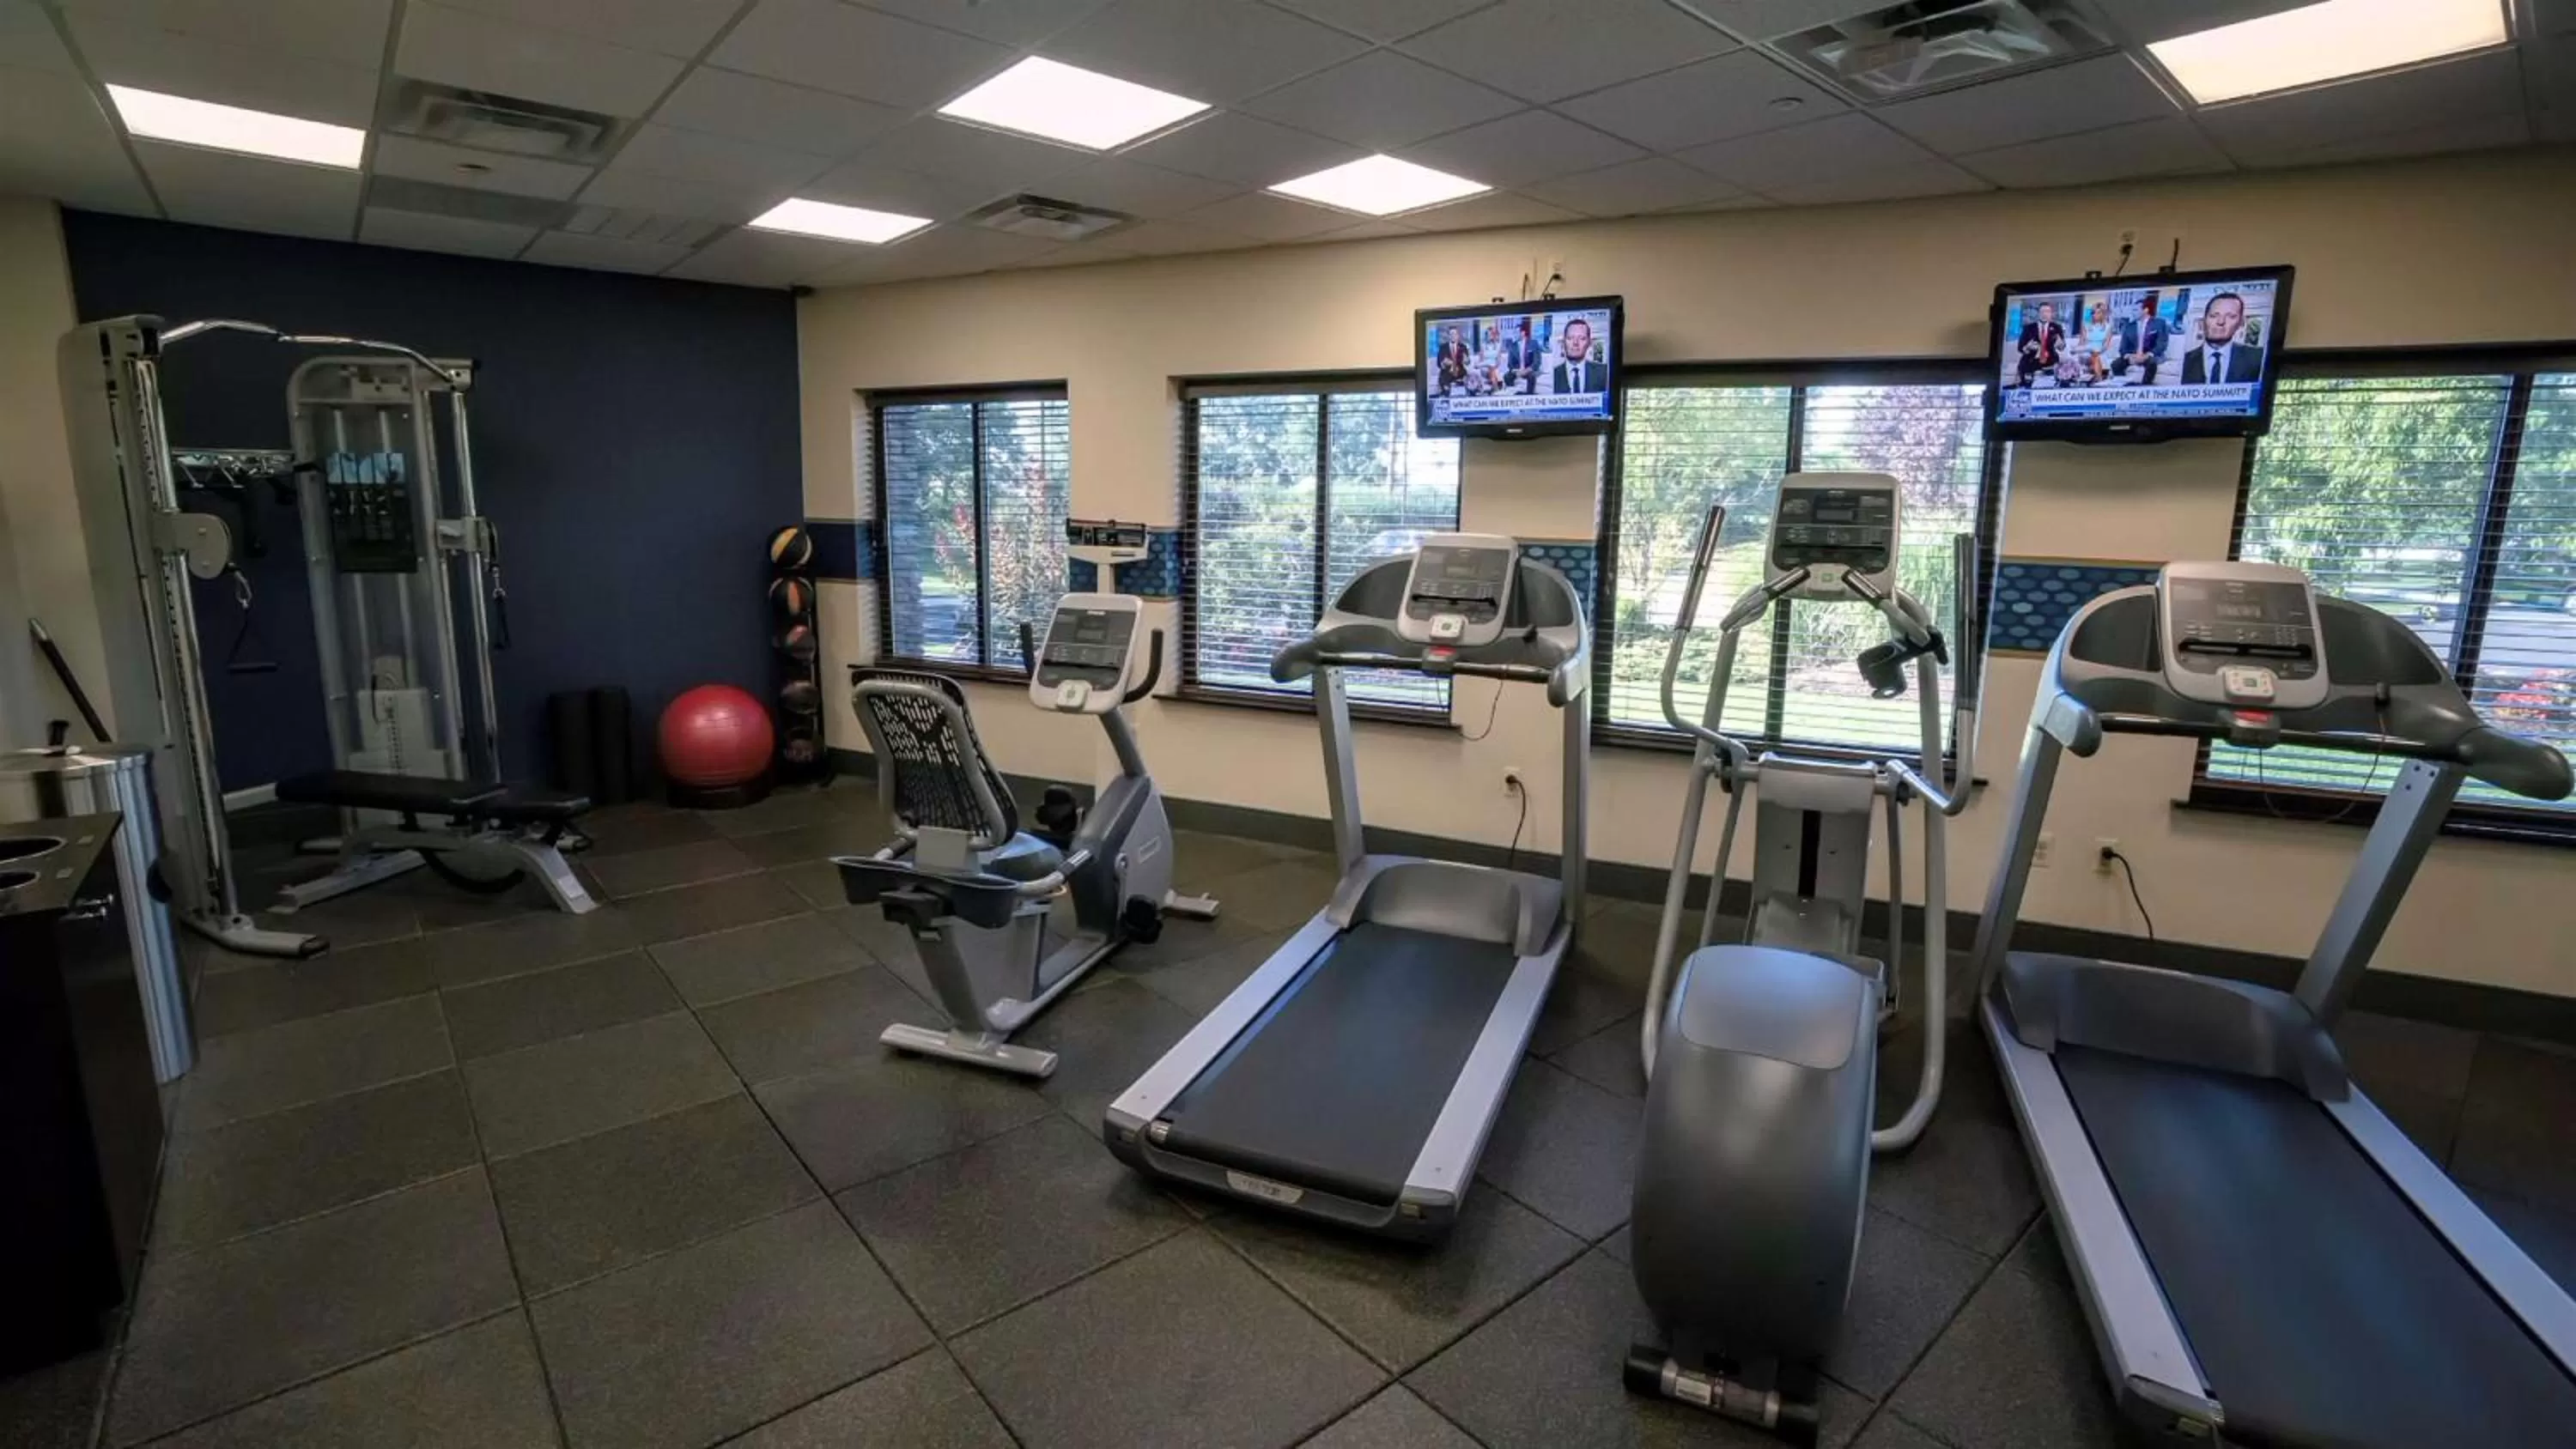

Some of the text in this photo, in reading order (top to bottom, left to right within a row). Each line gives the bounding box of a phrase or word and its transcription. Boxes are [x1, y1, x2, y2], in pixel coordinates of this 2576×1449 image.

[2035, 392, 2063, 403] WHAT
[2063, 392, 2085, 402] CAN
[2087, 391, 2101, 401] WE
[2104, 391, 2136, 400] EXPECT
[2138, 391, 2150, 399] AT
[2153, 390, 2169, 399] THE
[2171, 389, 2200, 398] NATO
